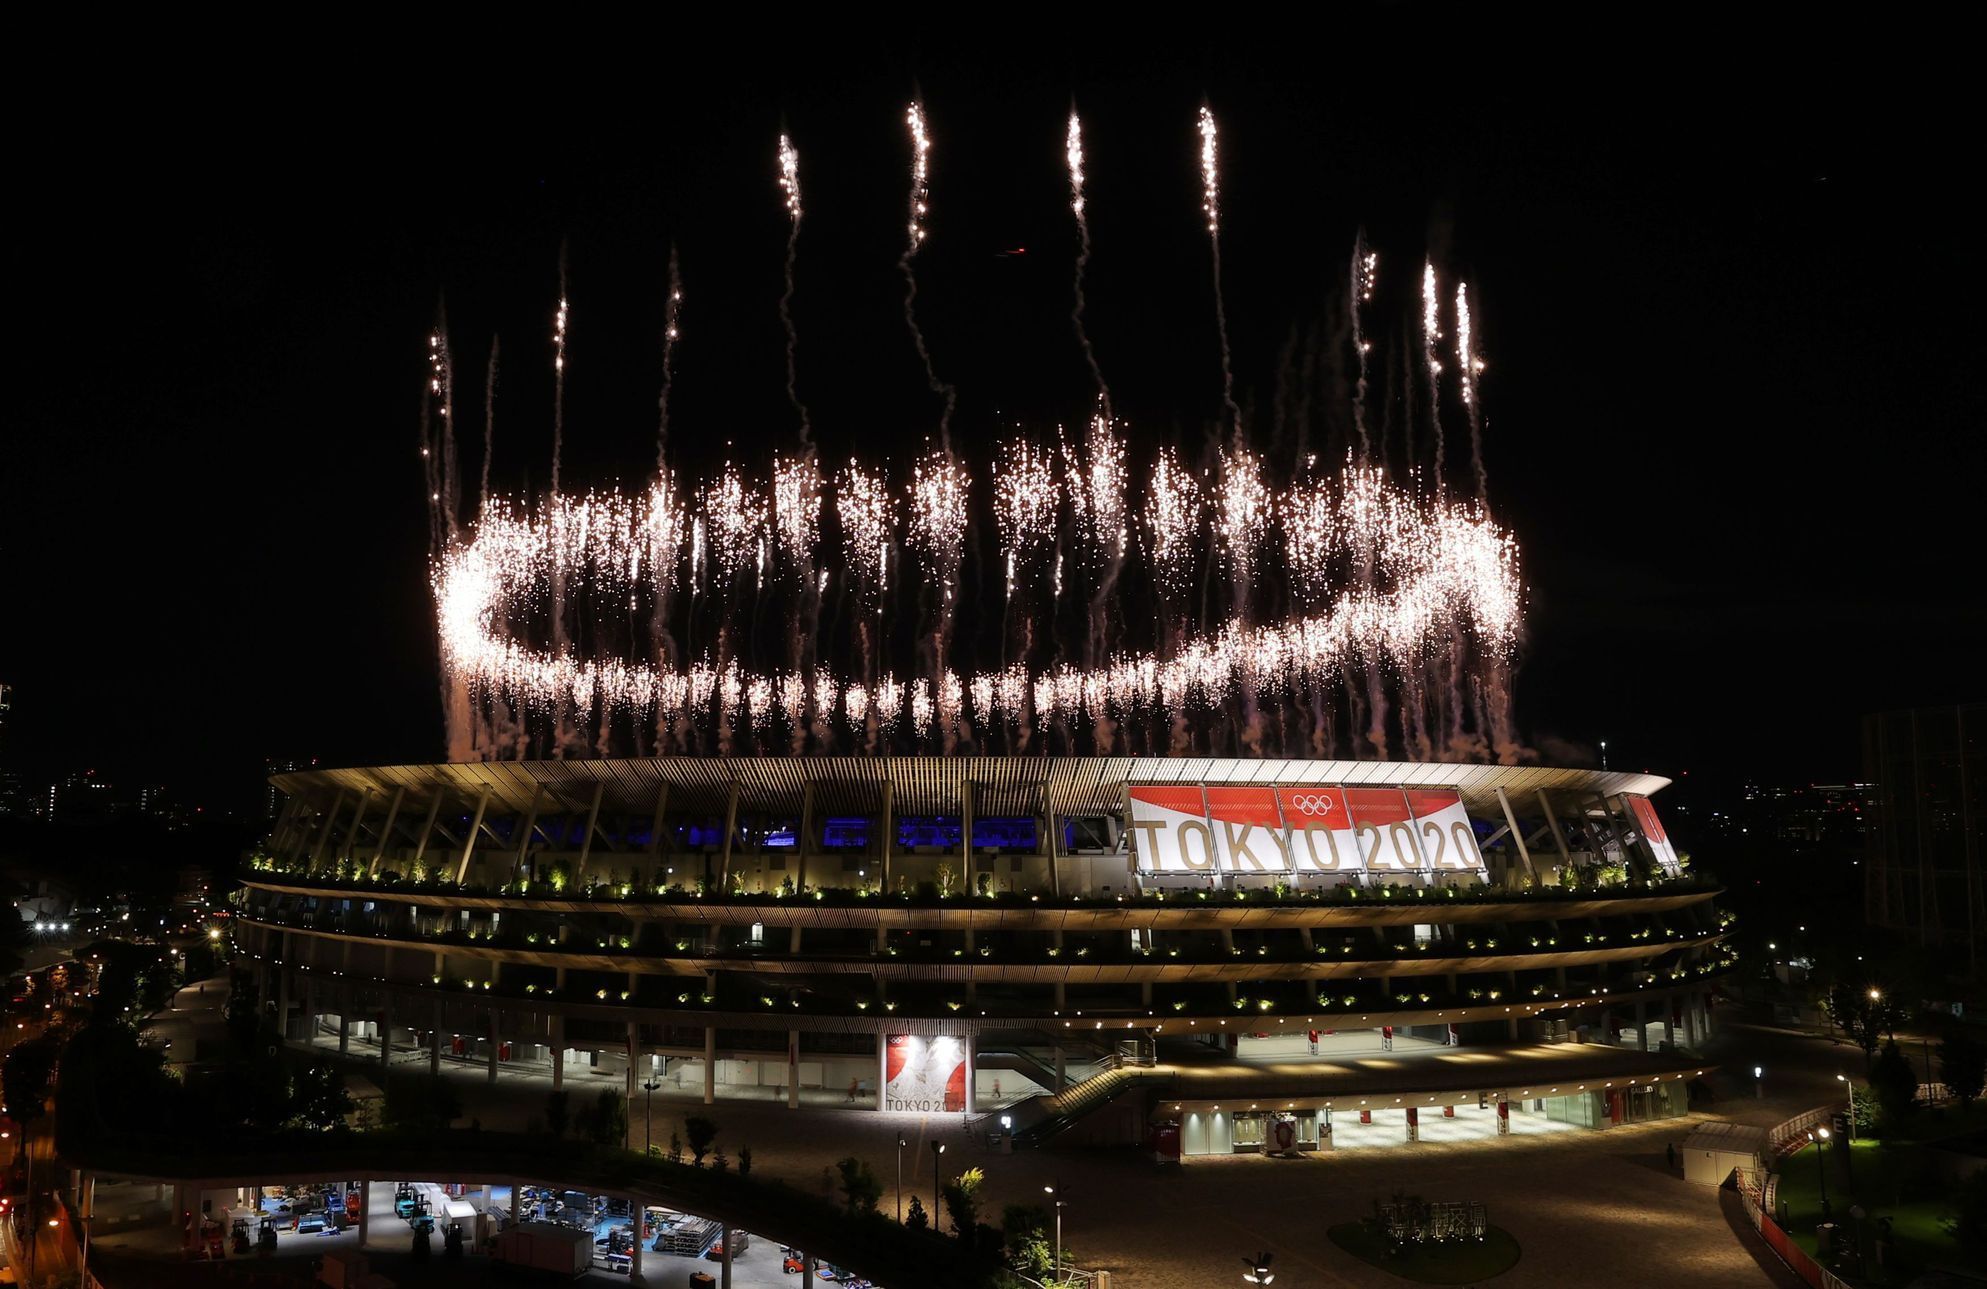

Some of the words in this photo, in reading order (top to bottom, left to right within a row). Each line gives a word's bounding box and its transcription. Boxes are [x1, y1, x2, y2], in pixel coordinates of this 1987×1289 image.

[1134, 820, 1340, 871] TOKYO
[1356, 821, 1483, 870] 2020
[886, 1099, 930, 1112] TOKYO
